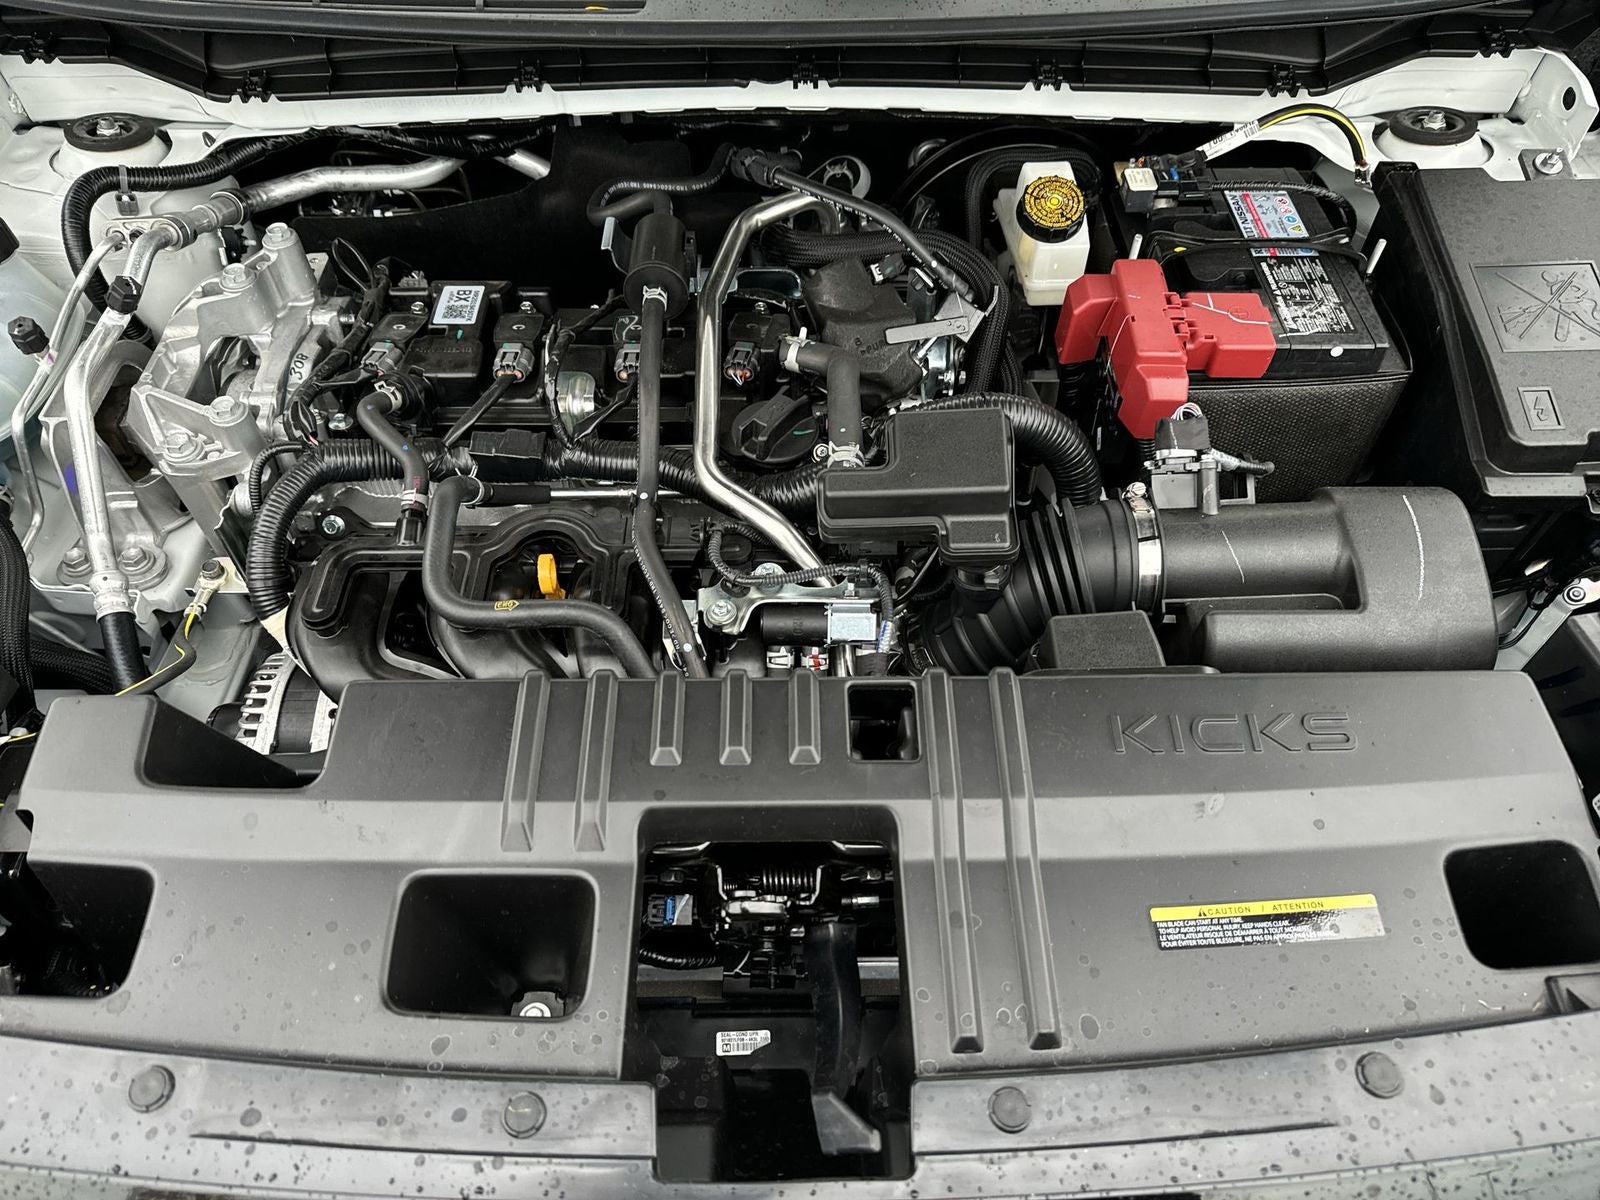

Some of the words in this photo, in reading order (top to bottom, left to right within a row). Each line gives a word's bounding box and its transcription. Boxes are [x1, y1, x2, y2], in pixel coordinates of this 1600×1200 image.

[1230, 194, 1249, 225] NISSAN
[454, 289, 472, 303] BX
[1110, 712, 1358, 754] KICKS
[1207, 906, 1250, 914] CAUTION
[1271, 901, 1323, 910] ATTENTION
[1166, 931, 1204, 940] VENTILATEUR
[1203, 930, 1224, 938] RISQUE
[1196, 937, 1215, 945] TOUTE
[1263, 933, 1272, 941] EN
